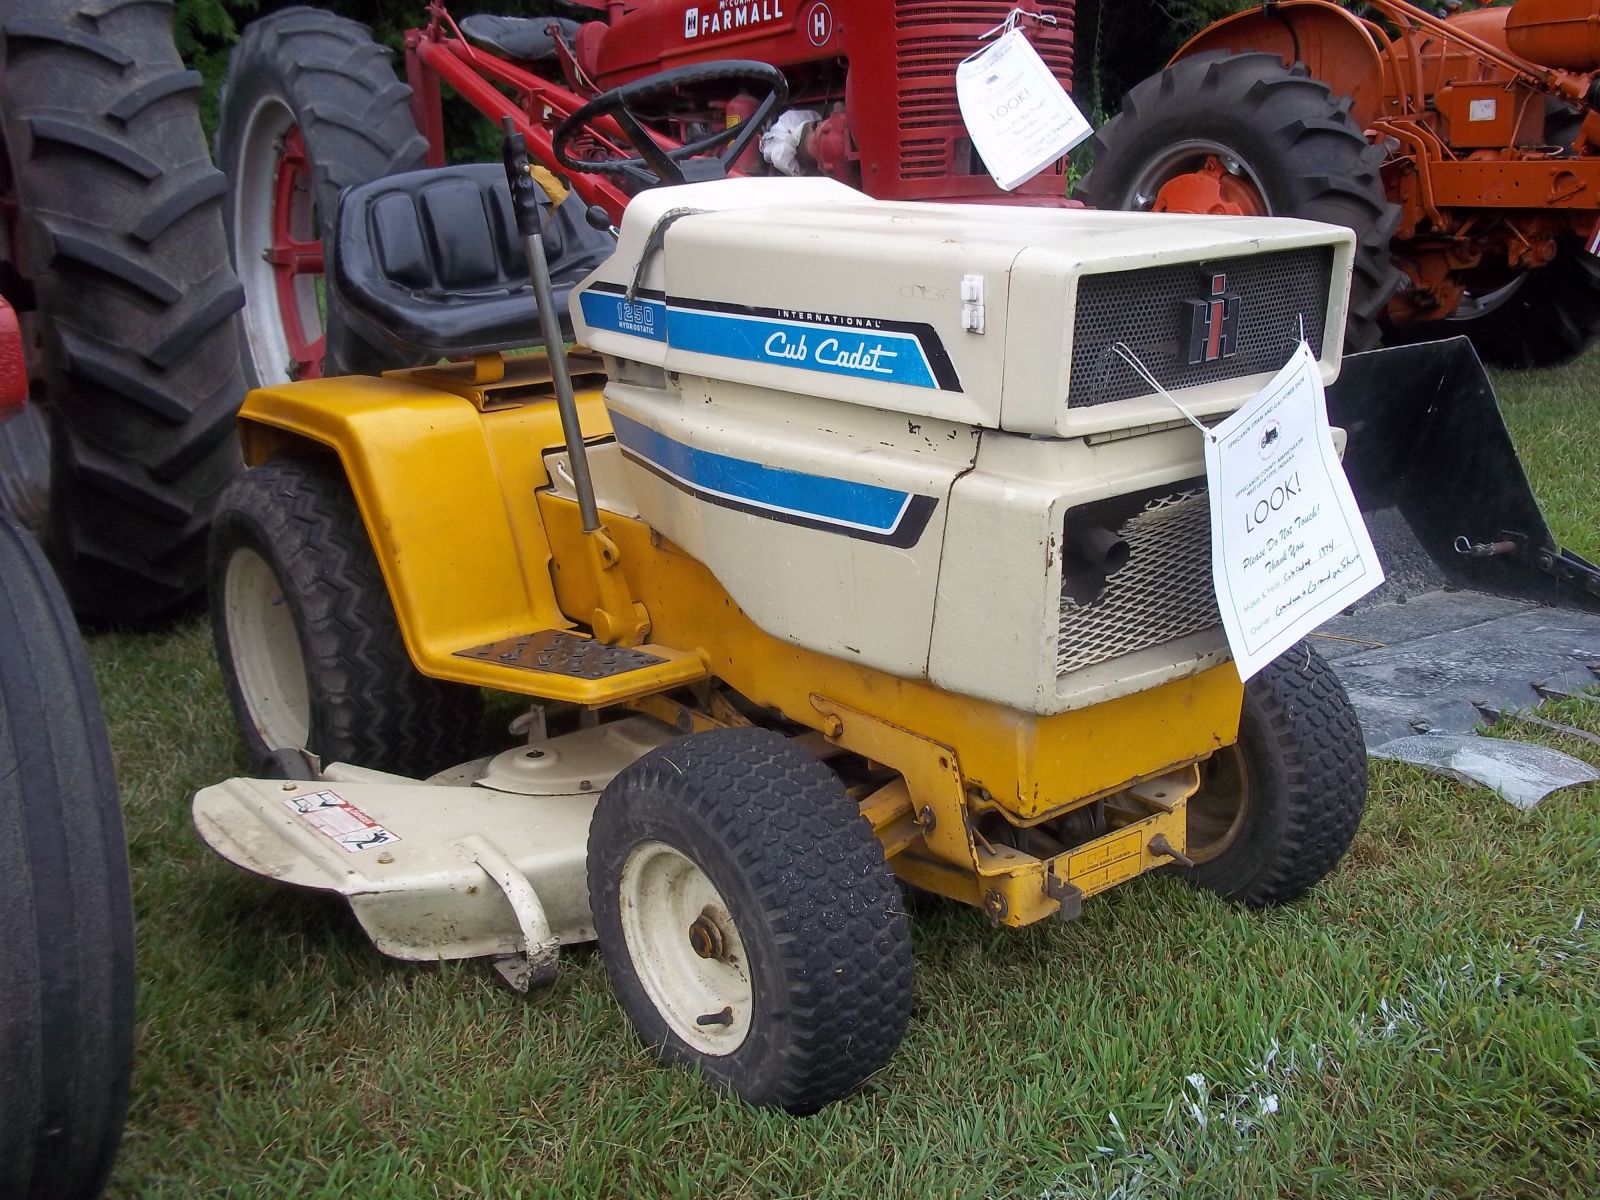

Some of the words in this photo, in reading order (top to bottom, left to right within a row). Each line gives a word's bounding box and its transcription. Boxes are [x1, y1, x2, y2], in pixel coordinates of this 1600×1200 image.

[702, 0, 783, 35] FARMALL
[814, 12, 825, 37] H
[617, 301, 654, 326] 1250
[777, 309, 881, 328] INTERNATIONAL
[619, 320, 655, 335] HYDROSTATIC
[764, 331, 808, 361] Cub
[815, 338, 898, 374] Cadet
[1246, 470, 1301, 533] LOOK!
[1243, 549, 1265, 573] Please
[1266, 538, 1278, 551] Do
[1279, 526, 1292, 540] Not
[1294, 503, 1320, 528] Touch!
[1265, 550, 1287, 574] Thank
